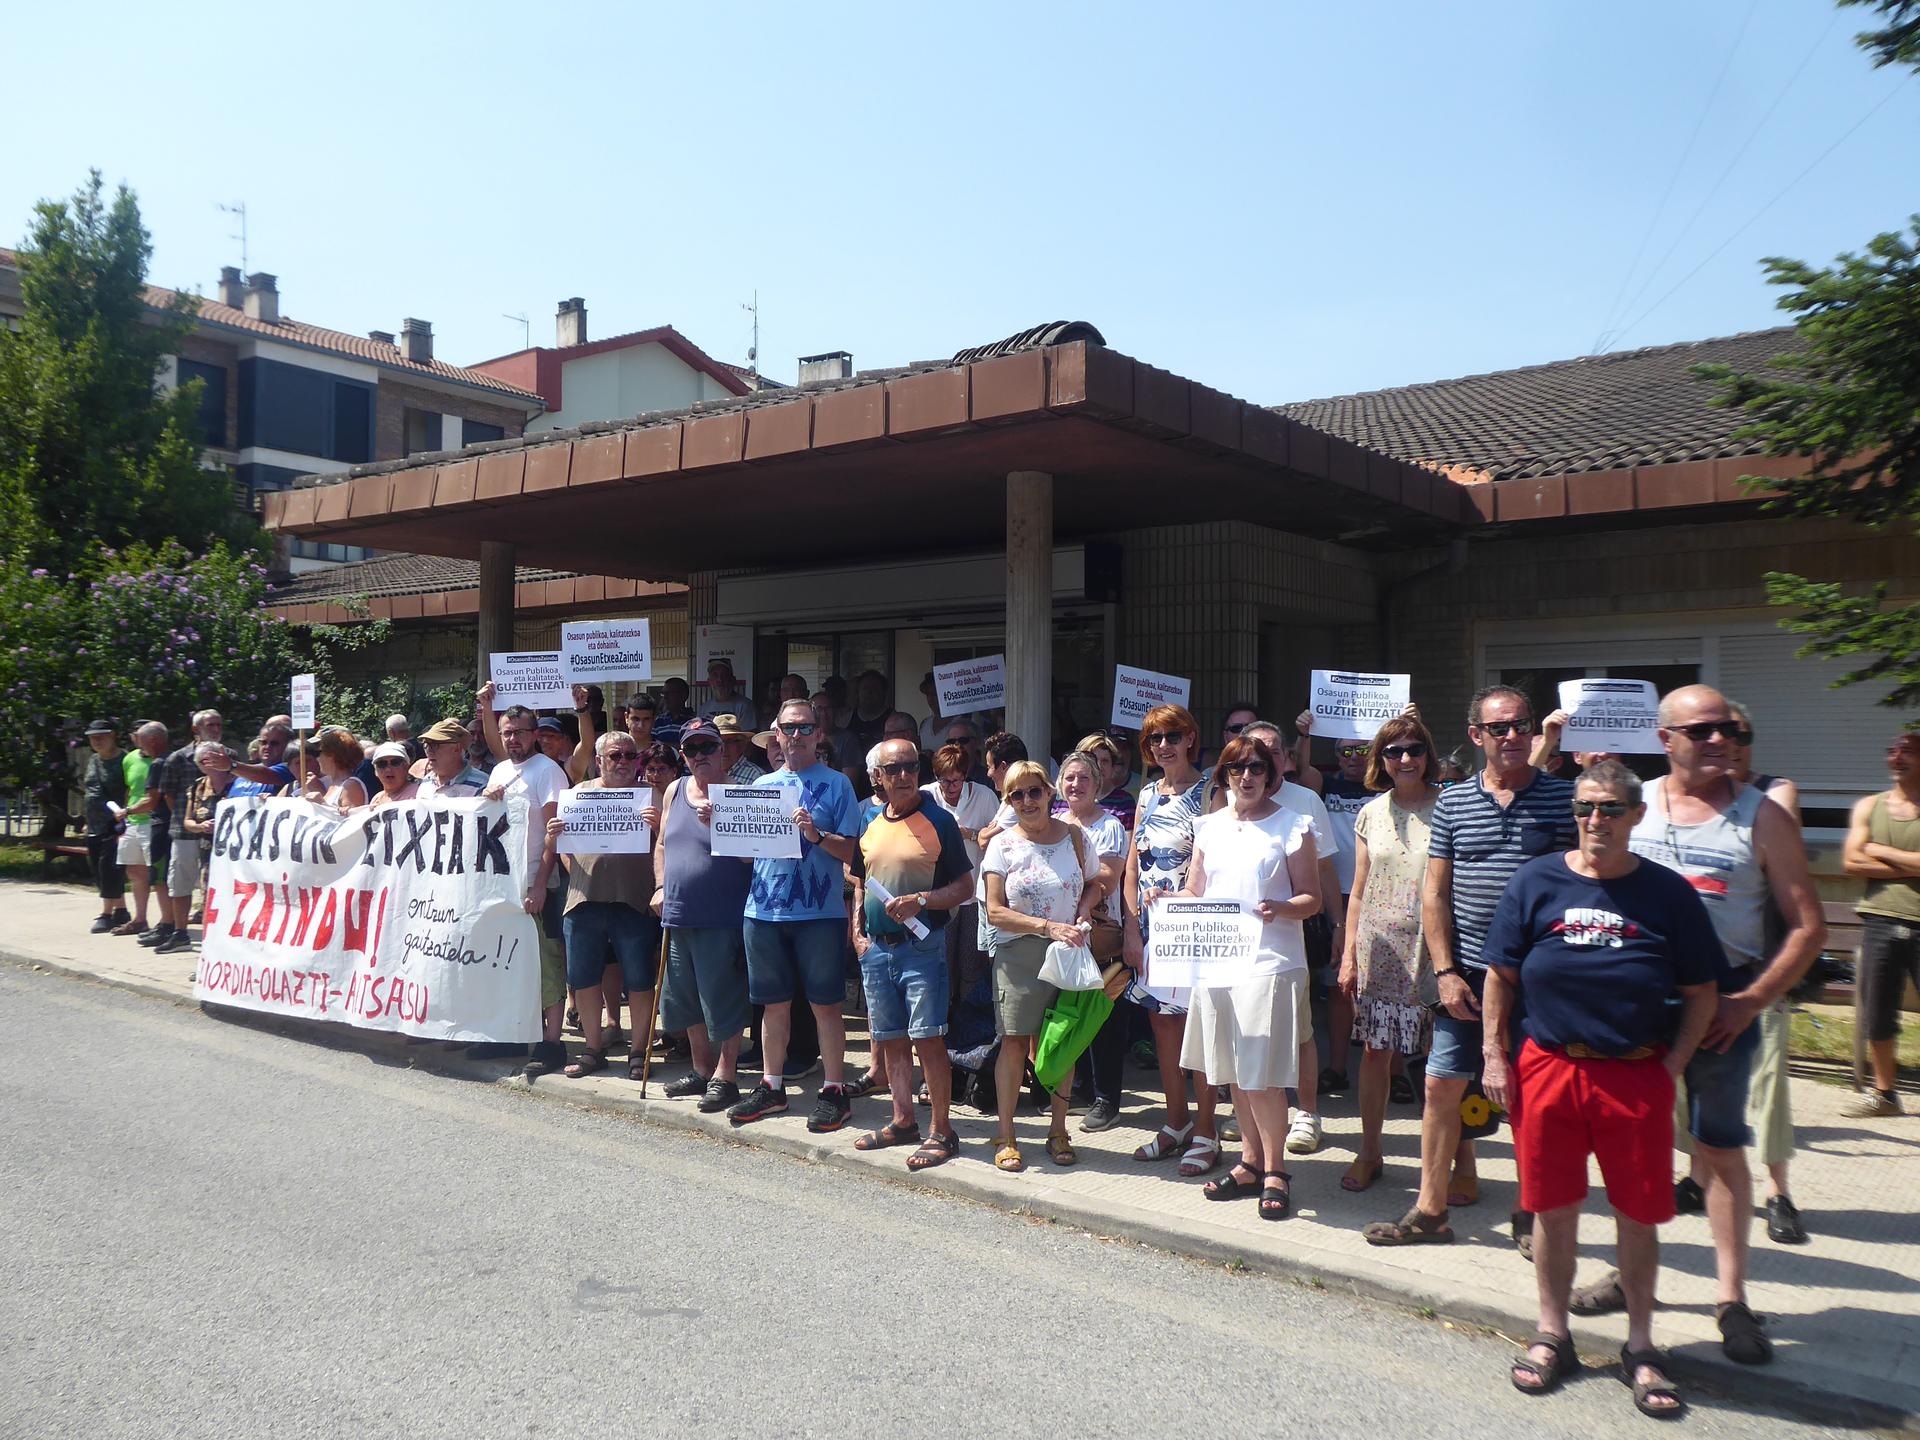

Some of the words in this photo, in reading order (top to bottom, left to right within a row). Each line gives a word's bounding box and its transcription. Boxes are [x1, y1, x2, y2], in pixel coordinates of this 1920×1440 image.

[567, 632, 585, 641] Osasun
[610, 629, 640, 639] kalitatezkoa
[588, 642, 596, 650] eta
[570, 651, 643, 665] #OsasunEtxeaZaindu
[496, 668, 524, 676] Osasun
[526, 667, 558, 675] Publikoa
[944, 683, 1004, 701] #OsasunEtxeaZaindu
[1318, 688, 1348, 698] Osasun
[1352, 690, 1389, 700] Publikoa
[1337, 698, 1349, 706] eta
[1352, 699, 1404, 708] kalitatezkoa
[577, 792, 633, 800] #OsasunEtxeaZaindu
[726, 790, 780, 798] #OsasunEtxeaZaindu
[564, 806, 594, 814] Osasun
[596, 804, 632, 813] Publikoa
[714, 804, 744, 812] Osasun
[746, 804, 780, 814] Publikoa
[563, 822, 644, 832] GUZTIENTZAT!
[716, 822, 792, 835] GUZTIENTZAT!
[215, 805, 345, 864] OSASUN
[361, 808, 510, 875] ETXEAK
[1168, 904, 1240, 913] #OsasunEtxeaZaindu
[1154, 922, 1189, 932] Osasun
[1192, 922, 1238, 932] Publikoa
[1174, 934, 1190, 942] eta
[1194, 933, 1256, 944] kalitatezkoa
[1156, 944, 1250, 957] GUZTIENTZAT!
